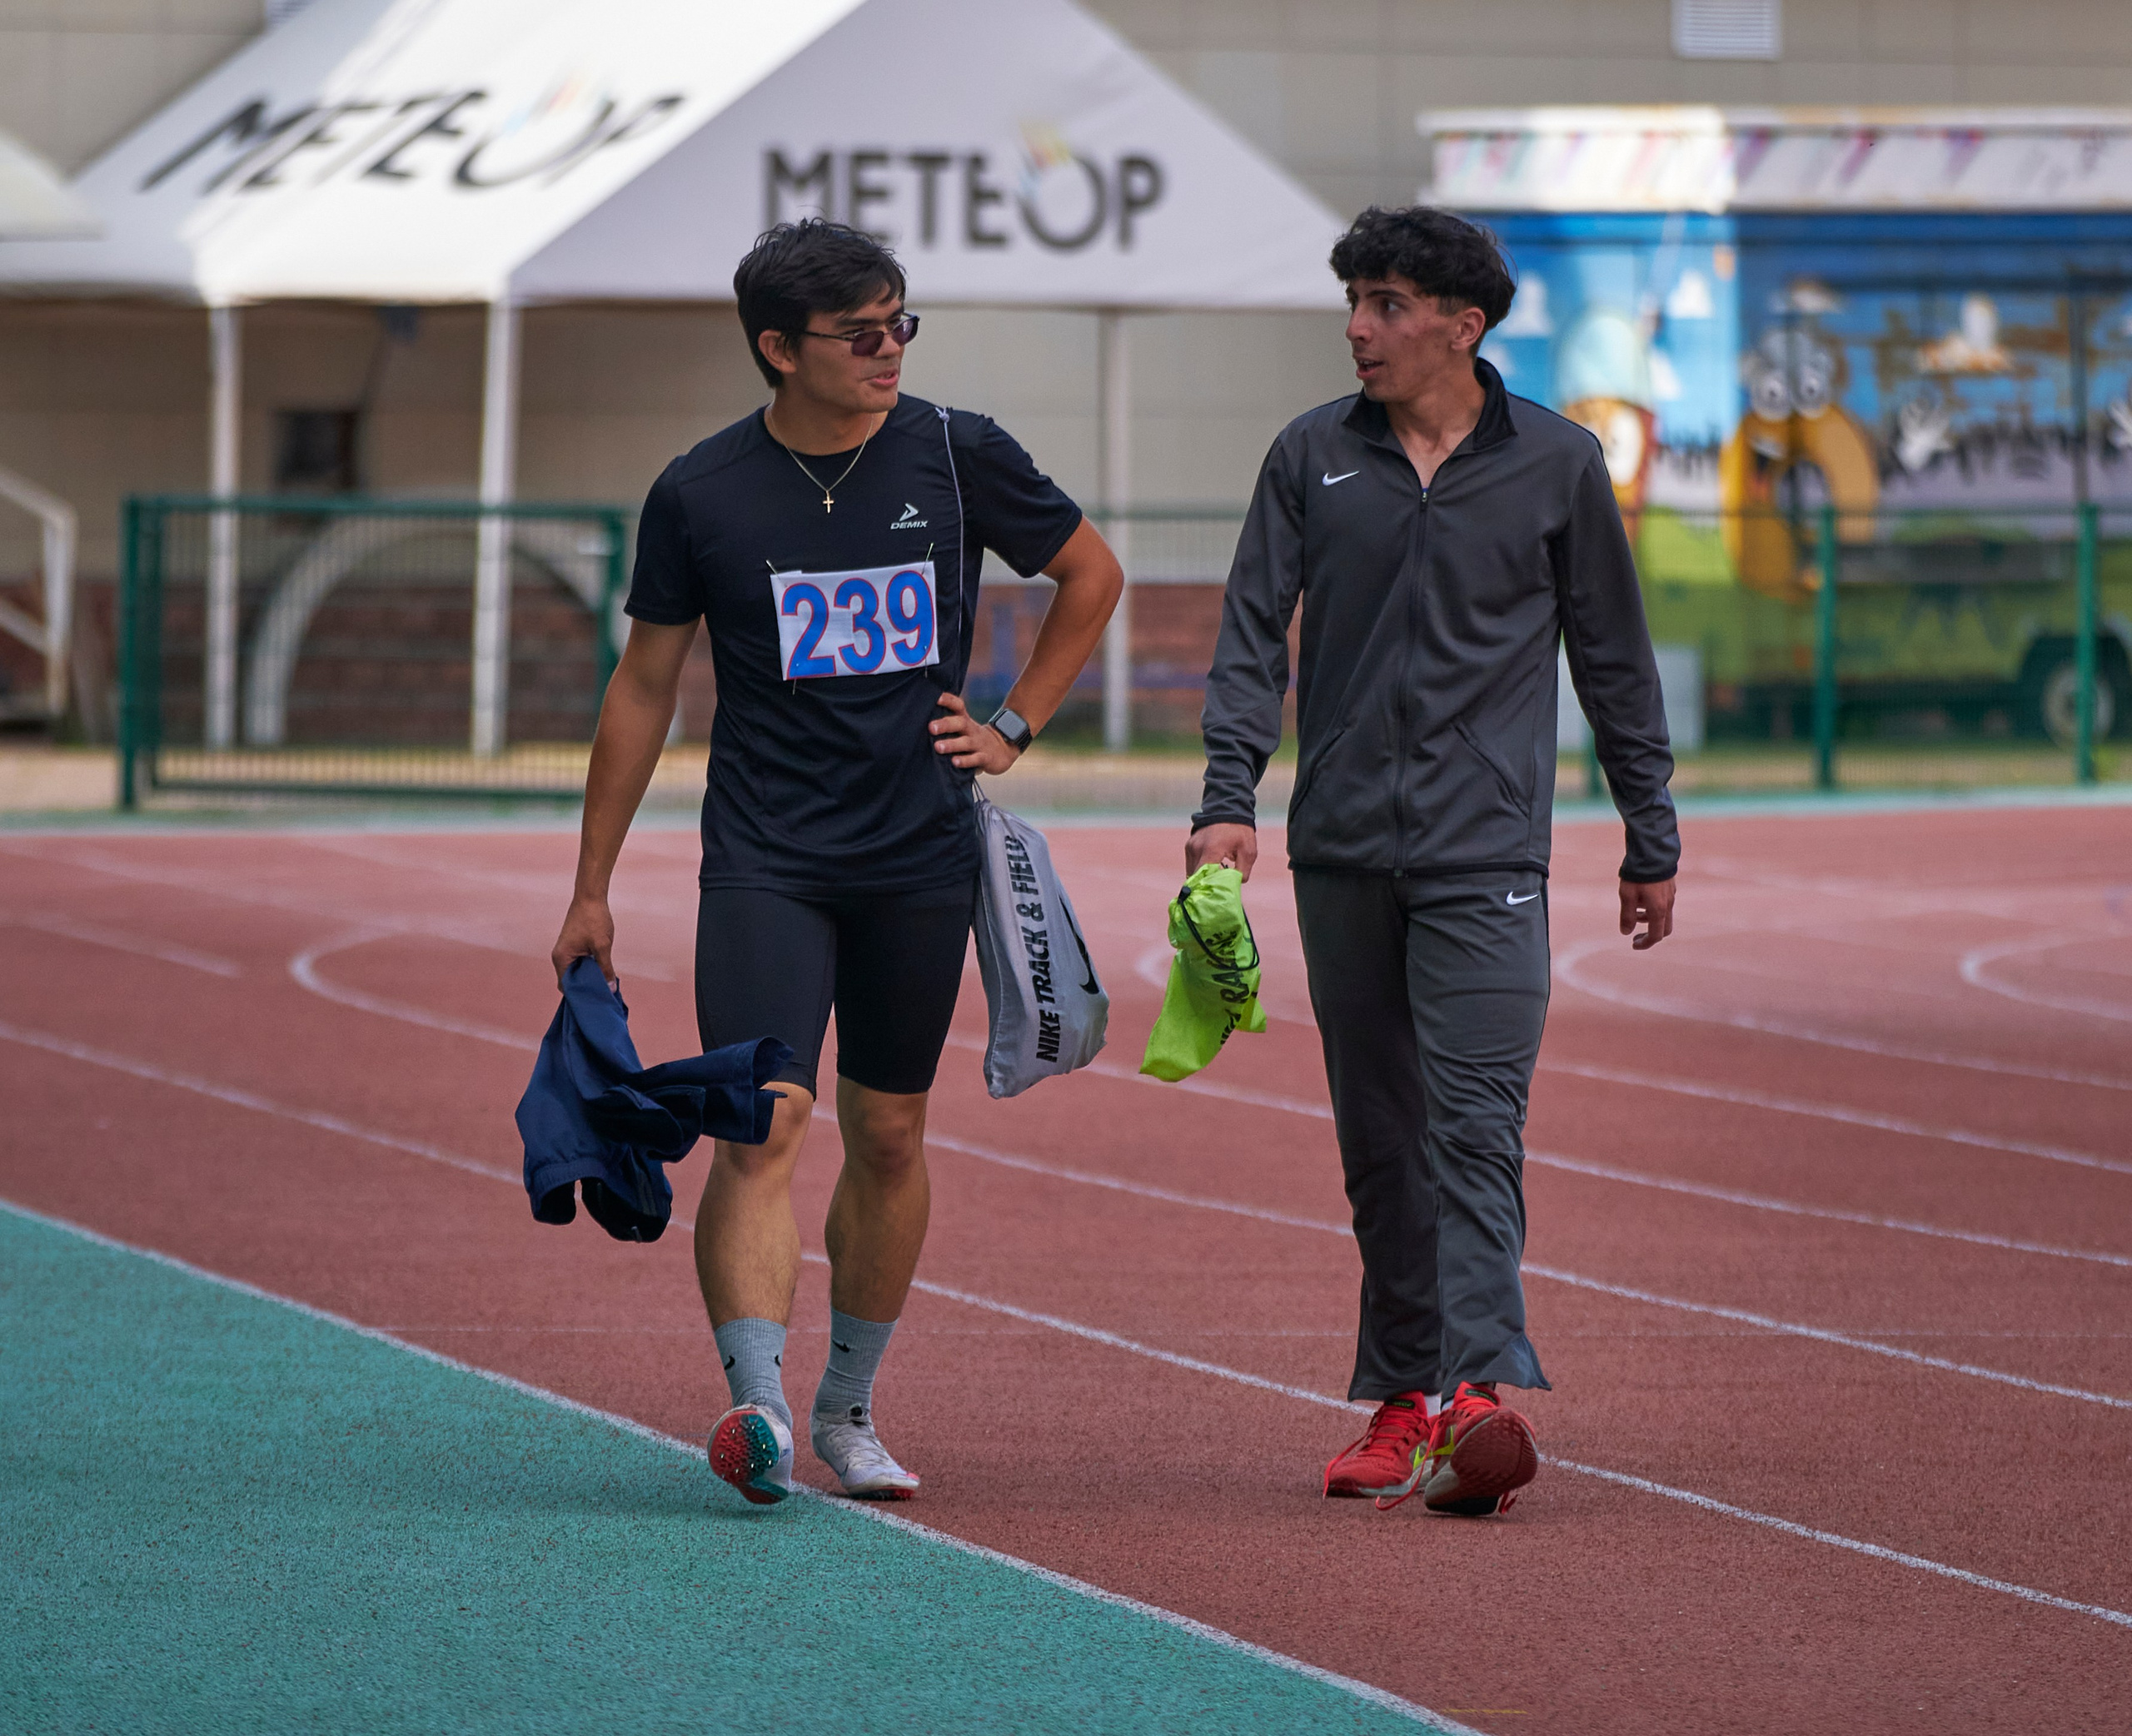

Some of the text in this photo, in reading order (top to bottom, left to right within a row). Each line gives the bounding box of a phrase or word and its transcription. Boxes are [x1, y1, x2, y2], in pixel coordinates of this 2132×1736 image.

[889, 520, 929, 530] DEMIX
[781, 570, 934, 679] 239
[1015, 903, 1044, 922] &
[1023, 927, 1055, 1004] TRACK
[1035, 1008, 1061, 1062] NIKE
